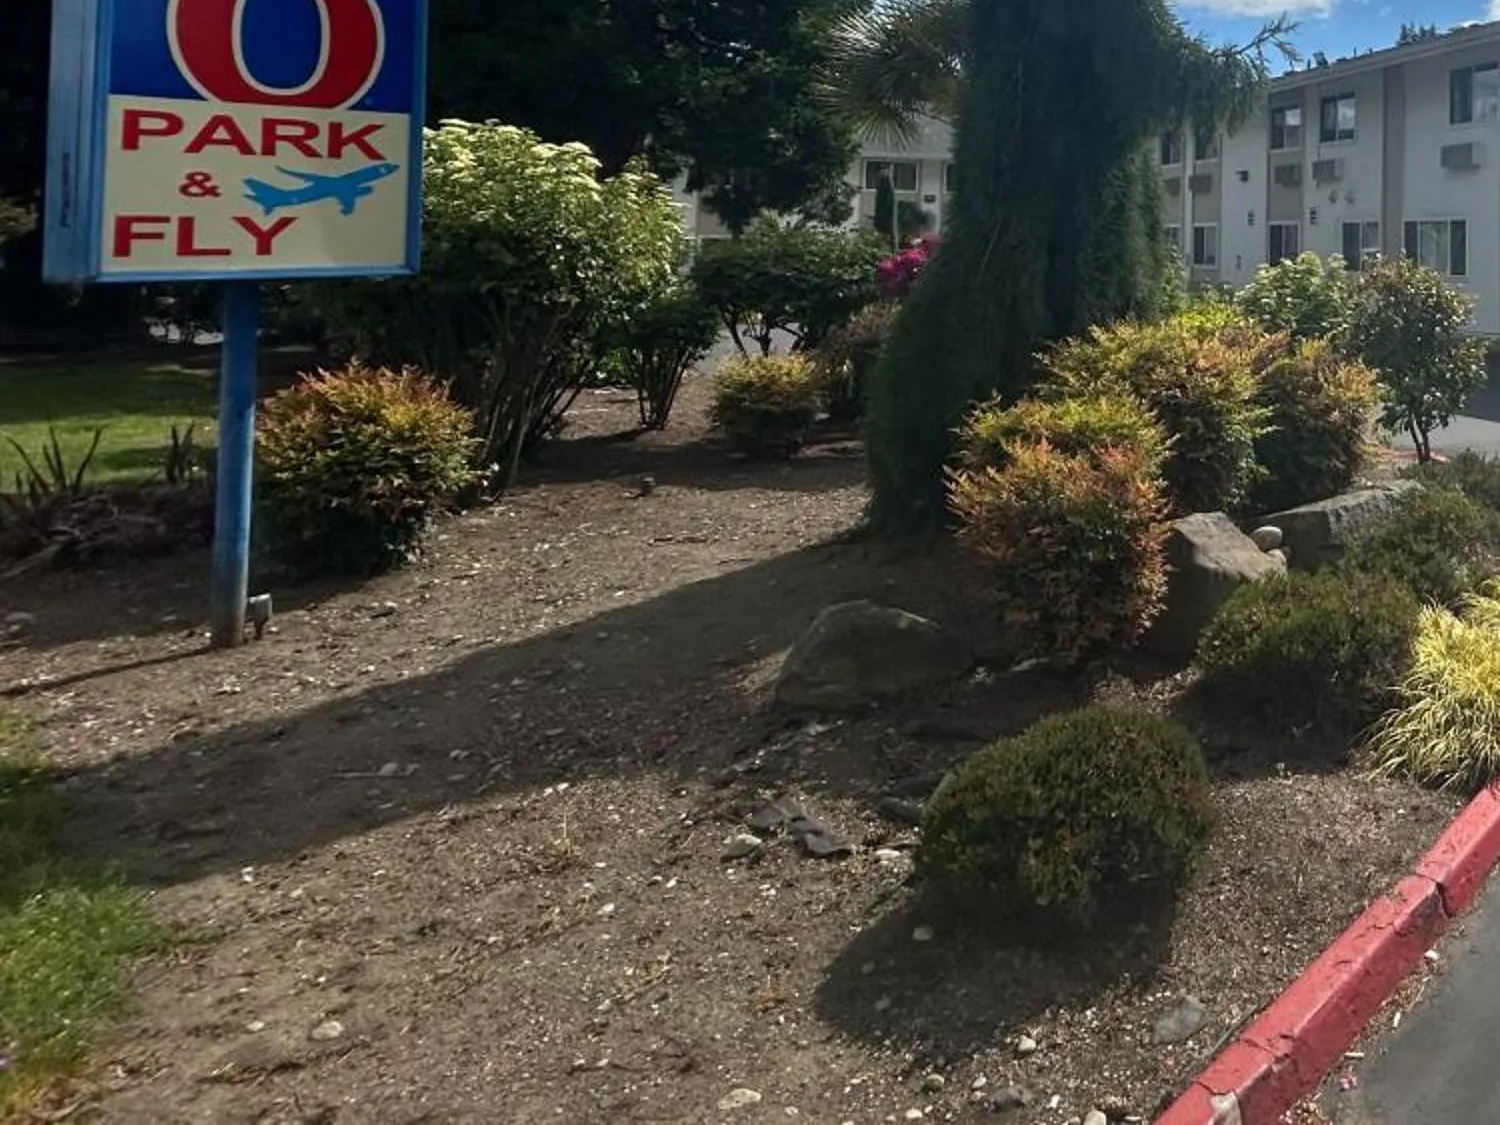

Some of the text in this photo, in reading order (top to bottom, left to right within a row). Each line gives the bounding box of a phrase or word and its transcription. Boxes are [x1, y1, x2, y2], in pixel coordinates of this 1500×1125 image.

[121, 109, 387, 161] PARK
[178, 171, 222, 197] &
[112, 215, 298, 258] FLY
